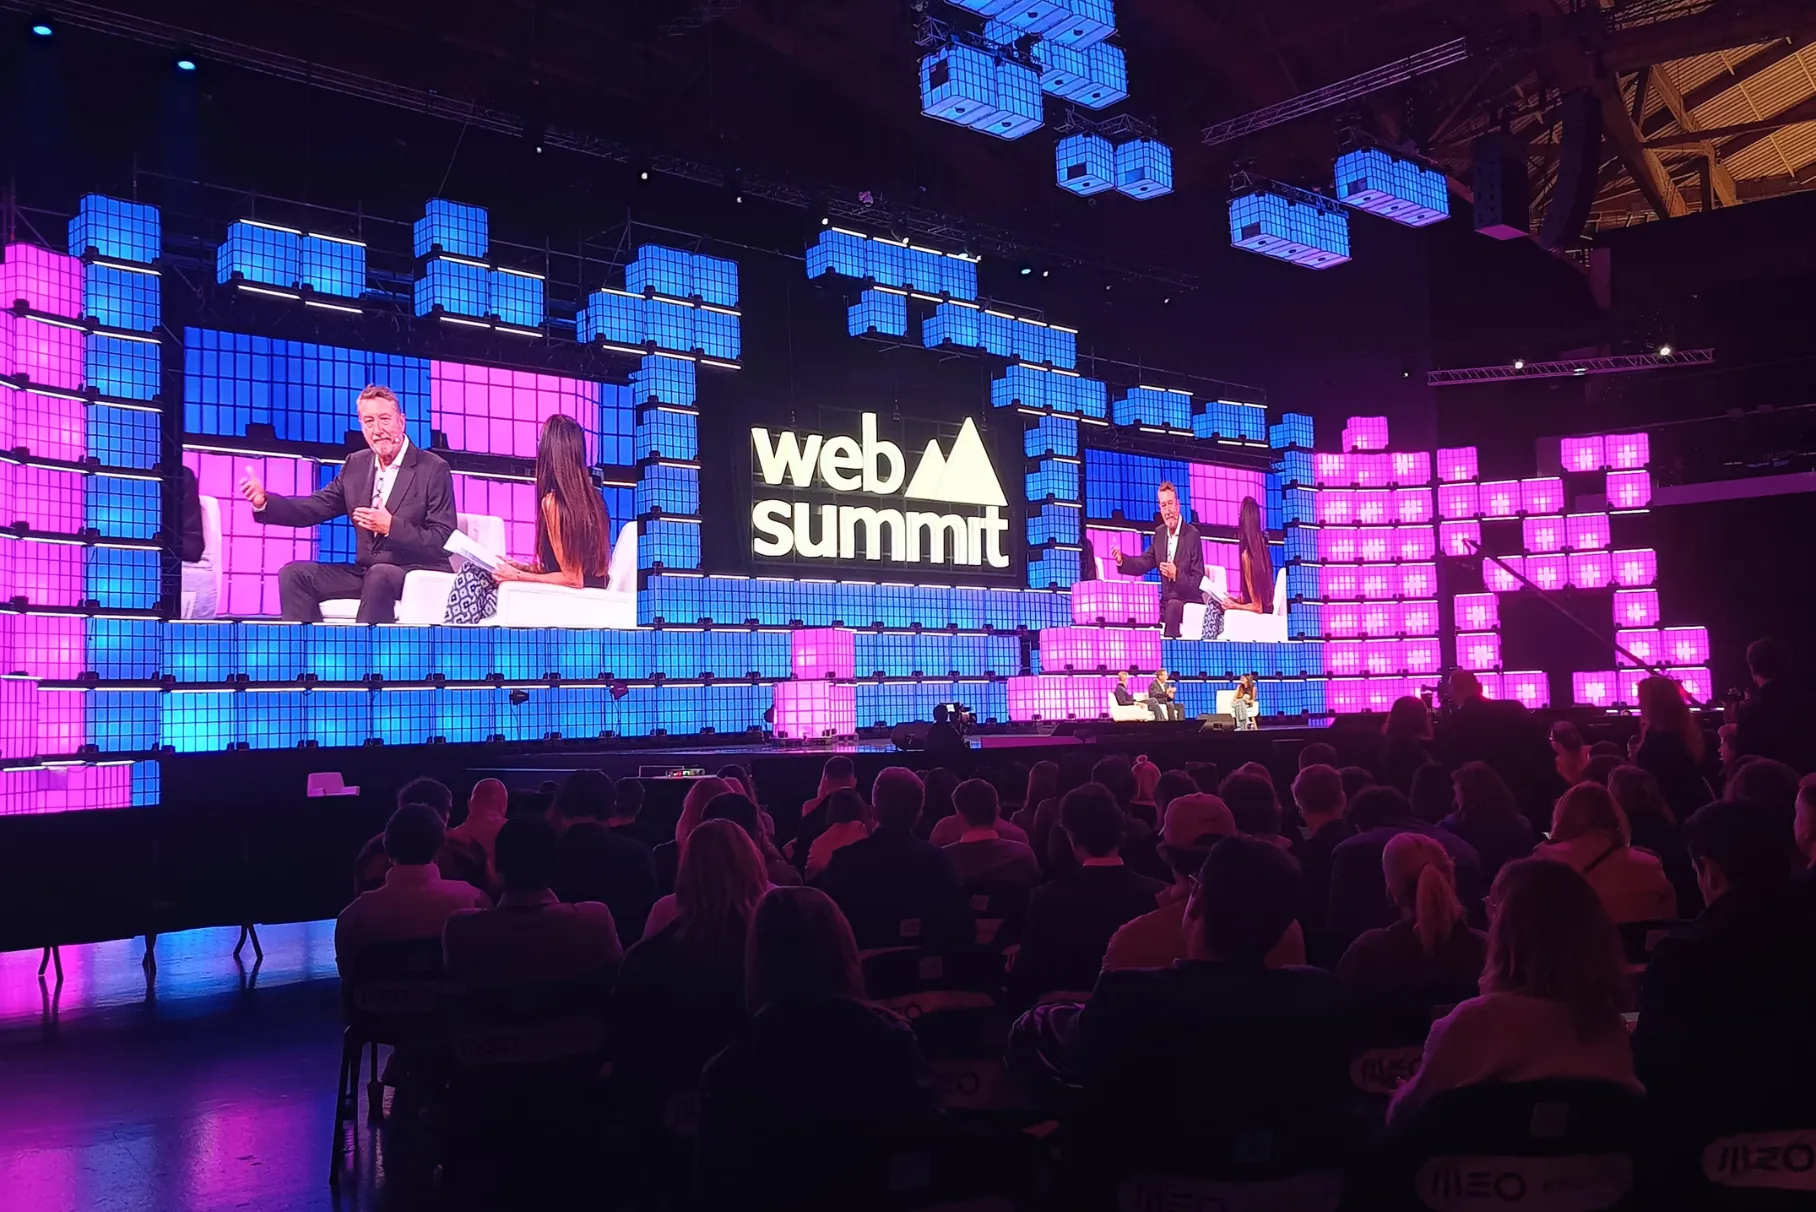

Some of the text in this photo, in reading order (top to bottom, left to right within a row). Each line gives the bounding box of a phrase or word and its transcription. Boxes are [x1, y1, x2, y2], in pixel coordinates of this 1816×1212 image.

[751, 412, 905, 495] web
[752, 500, 1009, 568] summit
[1718, 1144, 1815, 1174] MEO
[1430, 1168, 1526, 1202] MEO
